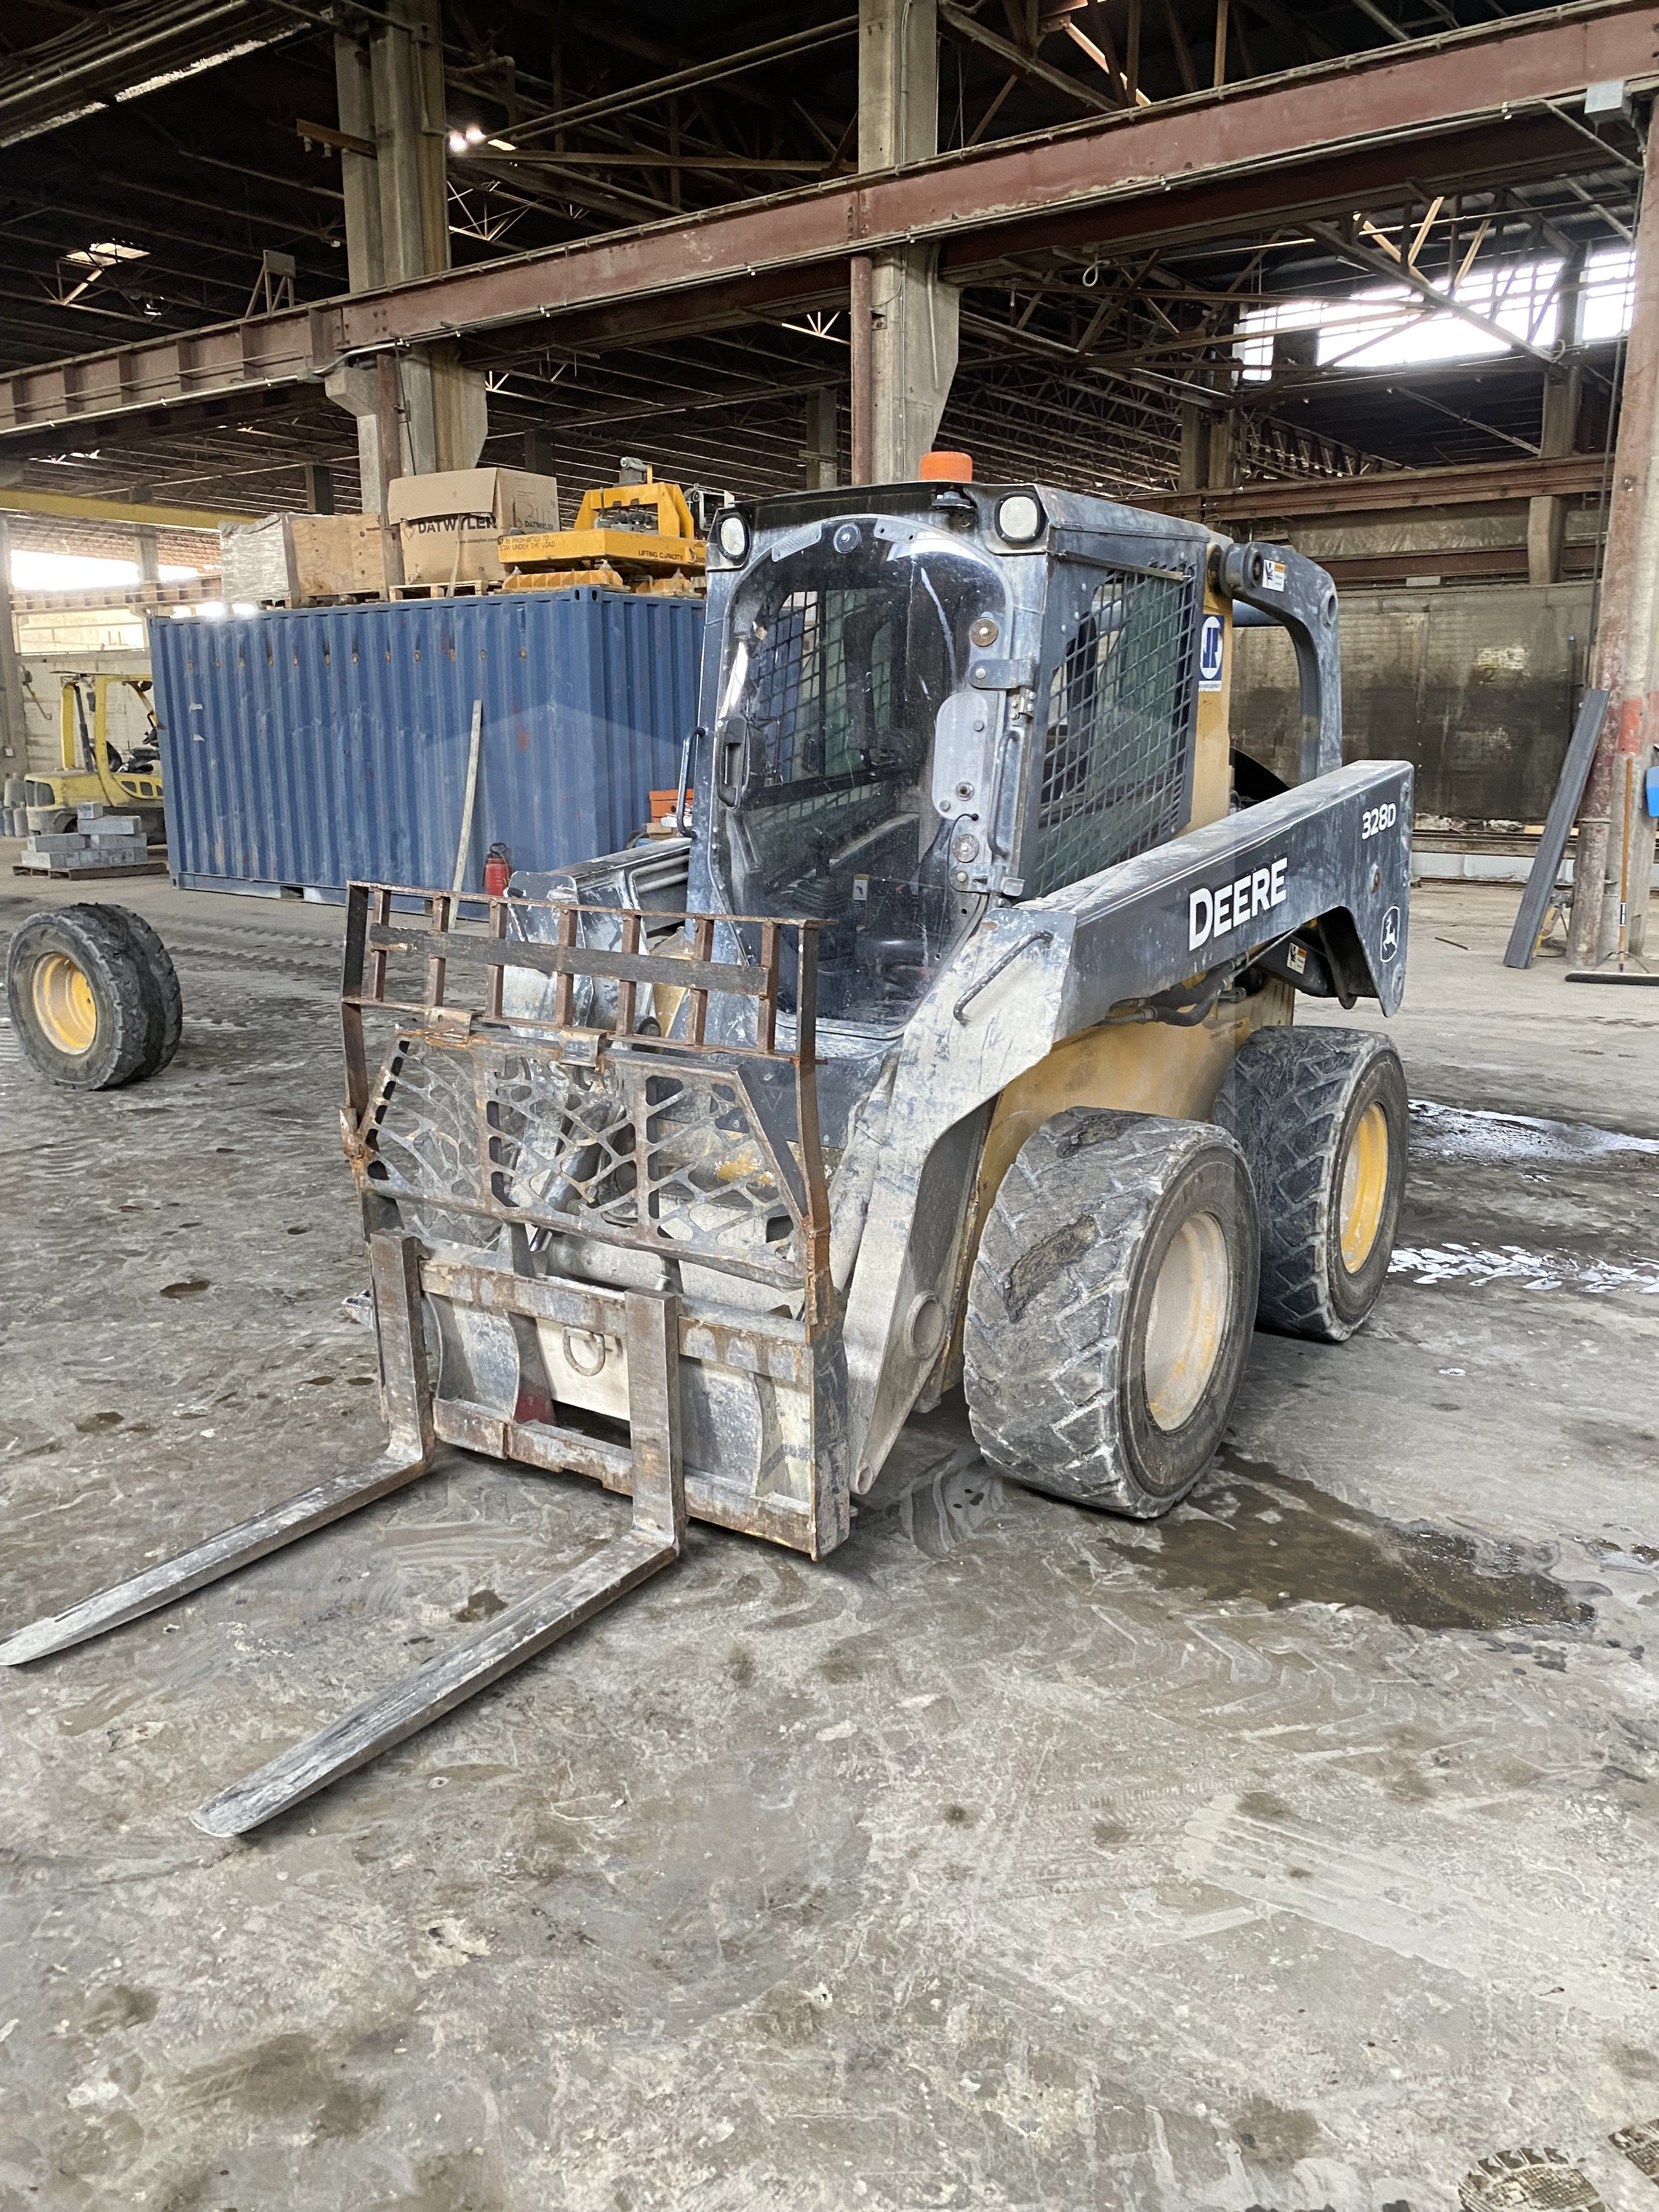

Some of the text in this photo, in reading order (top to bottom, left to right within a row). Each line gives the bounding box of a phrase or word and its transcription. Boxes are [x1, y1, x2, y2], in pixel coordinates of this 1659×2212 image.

[418, 516, 497, 534] DATWYLER
[1362, 803, 1397, 840] 328D
[1189, 857, 1288, 952] DEERE
